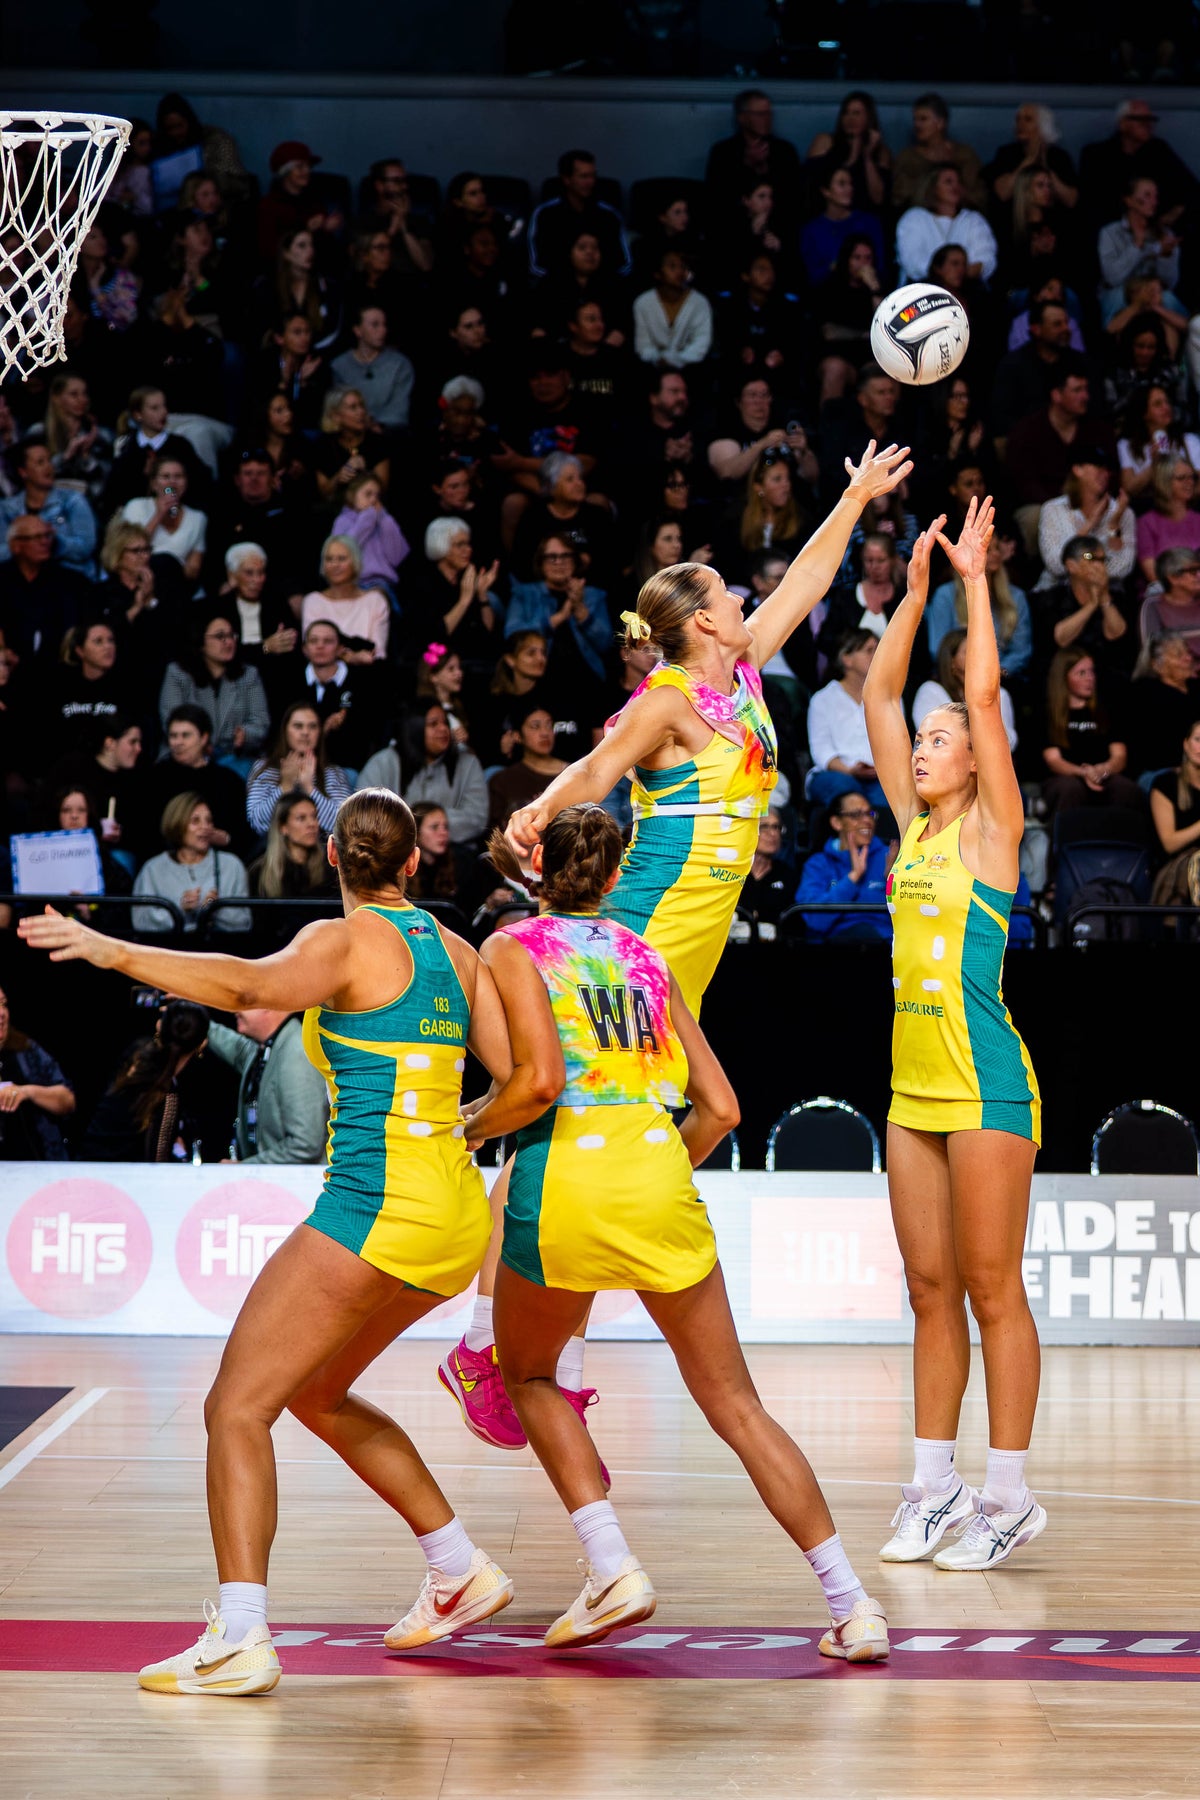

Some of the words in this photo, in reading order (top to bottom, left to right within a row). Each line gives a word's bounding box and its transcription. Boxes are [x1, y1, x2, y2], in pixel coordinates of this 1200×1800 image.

[900, 879, 933, 889] priceline
[900, 890, 937, 902] pharmacy
[433, 996, 450, 1013] 183
[895, 1000, 944, 1018] ELBOURNE
[577, 984, 661, 1054] WA
[419, 1017, 463, 1040] GARBIN
[1024, 1200, 1157, 1252] ADE
